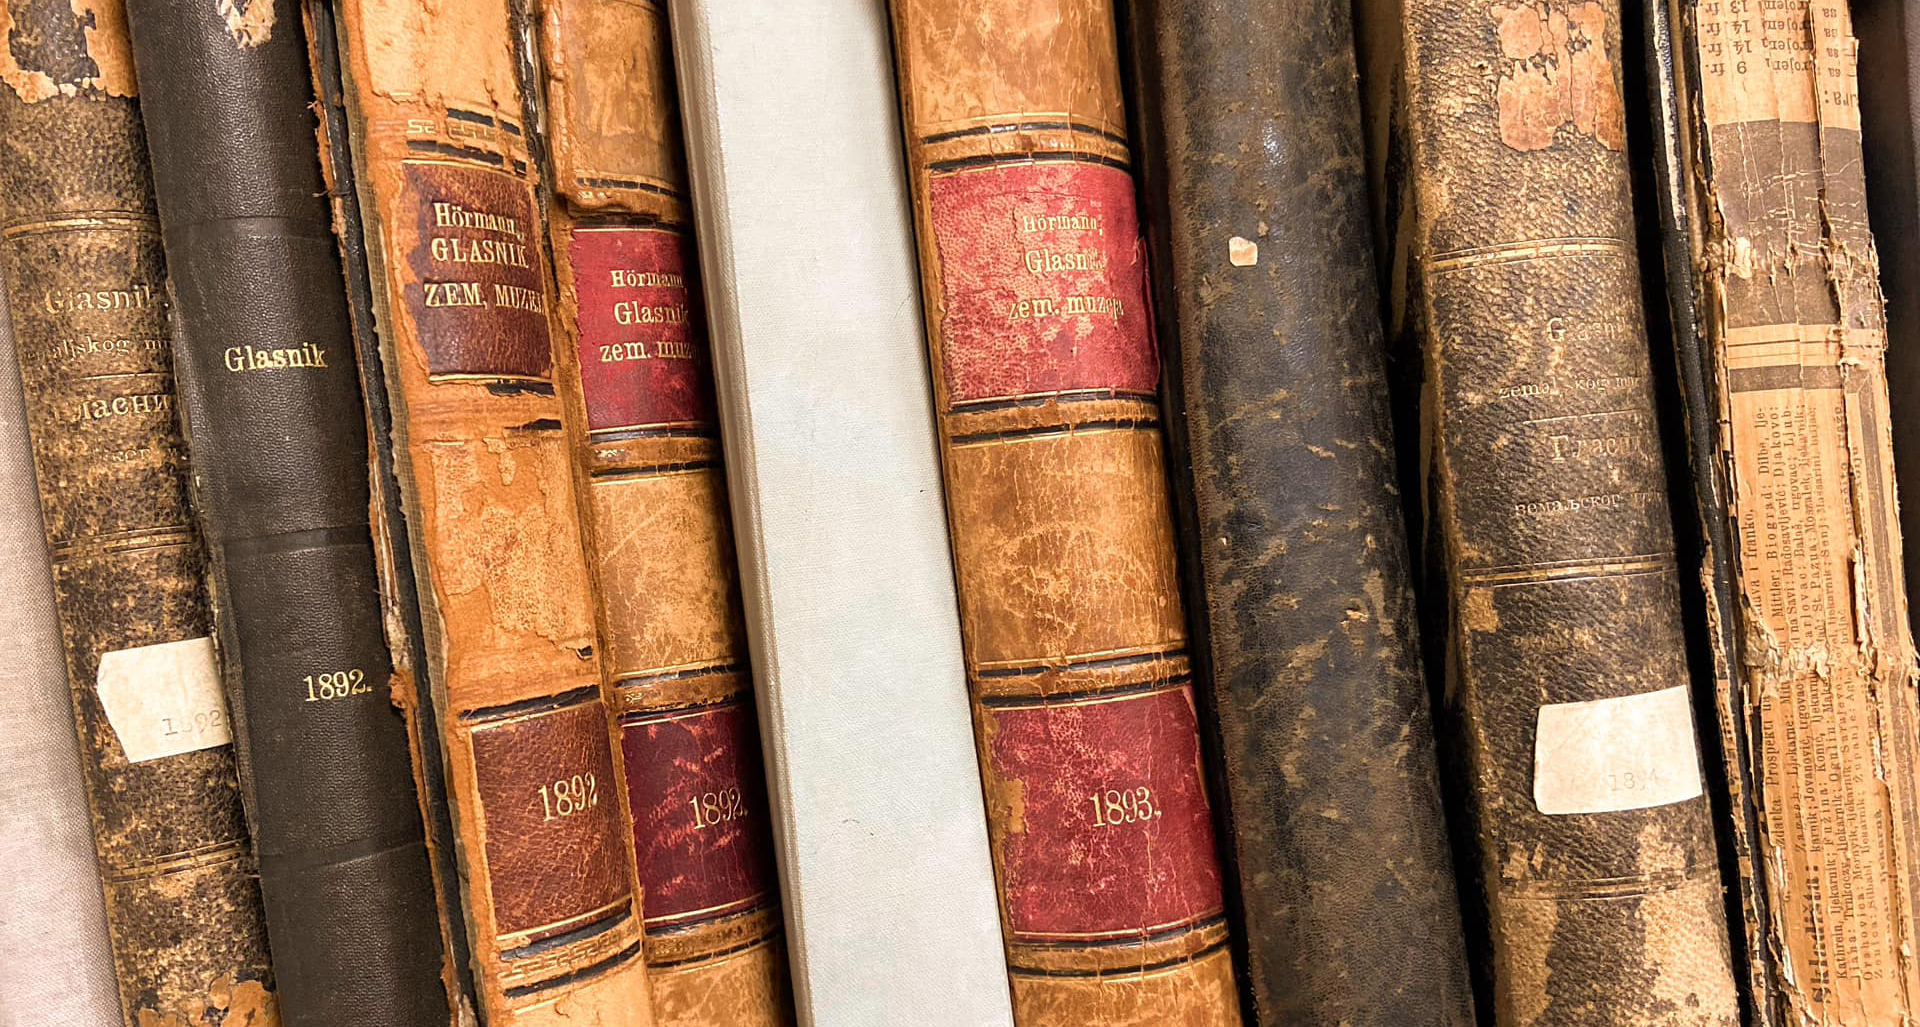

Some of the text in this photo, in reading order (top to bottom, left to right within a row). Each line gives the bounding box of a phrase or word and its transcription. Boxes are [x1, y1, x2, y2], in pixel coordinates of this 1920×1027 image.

[1700, 2, 1720, 15] fr.
[1730, 2, 1749, 14] 13
[1701, 22, 1721, 36] fr.
[1732, 20, 1750, 34] 14
[1702, 42, 1722, 56] fr.
[1733, 40, 1752, 54] 14
[1705, 63, 1725, 76] fr.
[1737, 61, 1747, 74] 9
[1022, 214, 1103, 236] Hörmann,
[431, 237, 529, 269] GLASNIK
[1008, 298, 1060, 320] zem.
[223, 341, 328, 372] Glasnik
[600, 341, 652, 362] zem.
[303, 668, 372, 702] 1892.
[538, 772, 598, 822] 1892
[1089, 786, 1162, 828] 1893.
